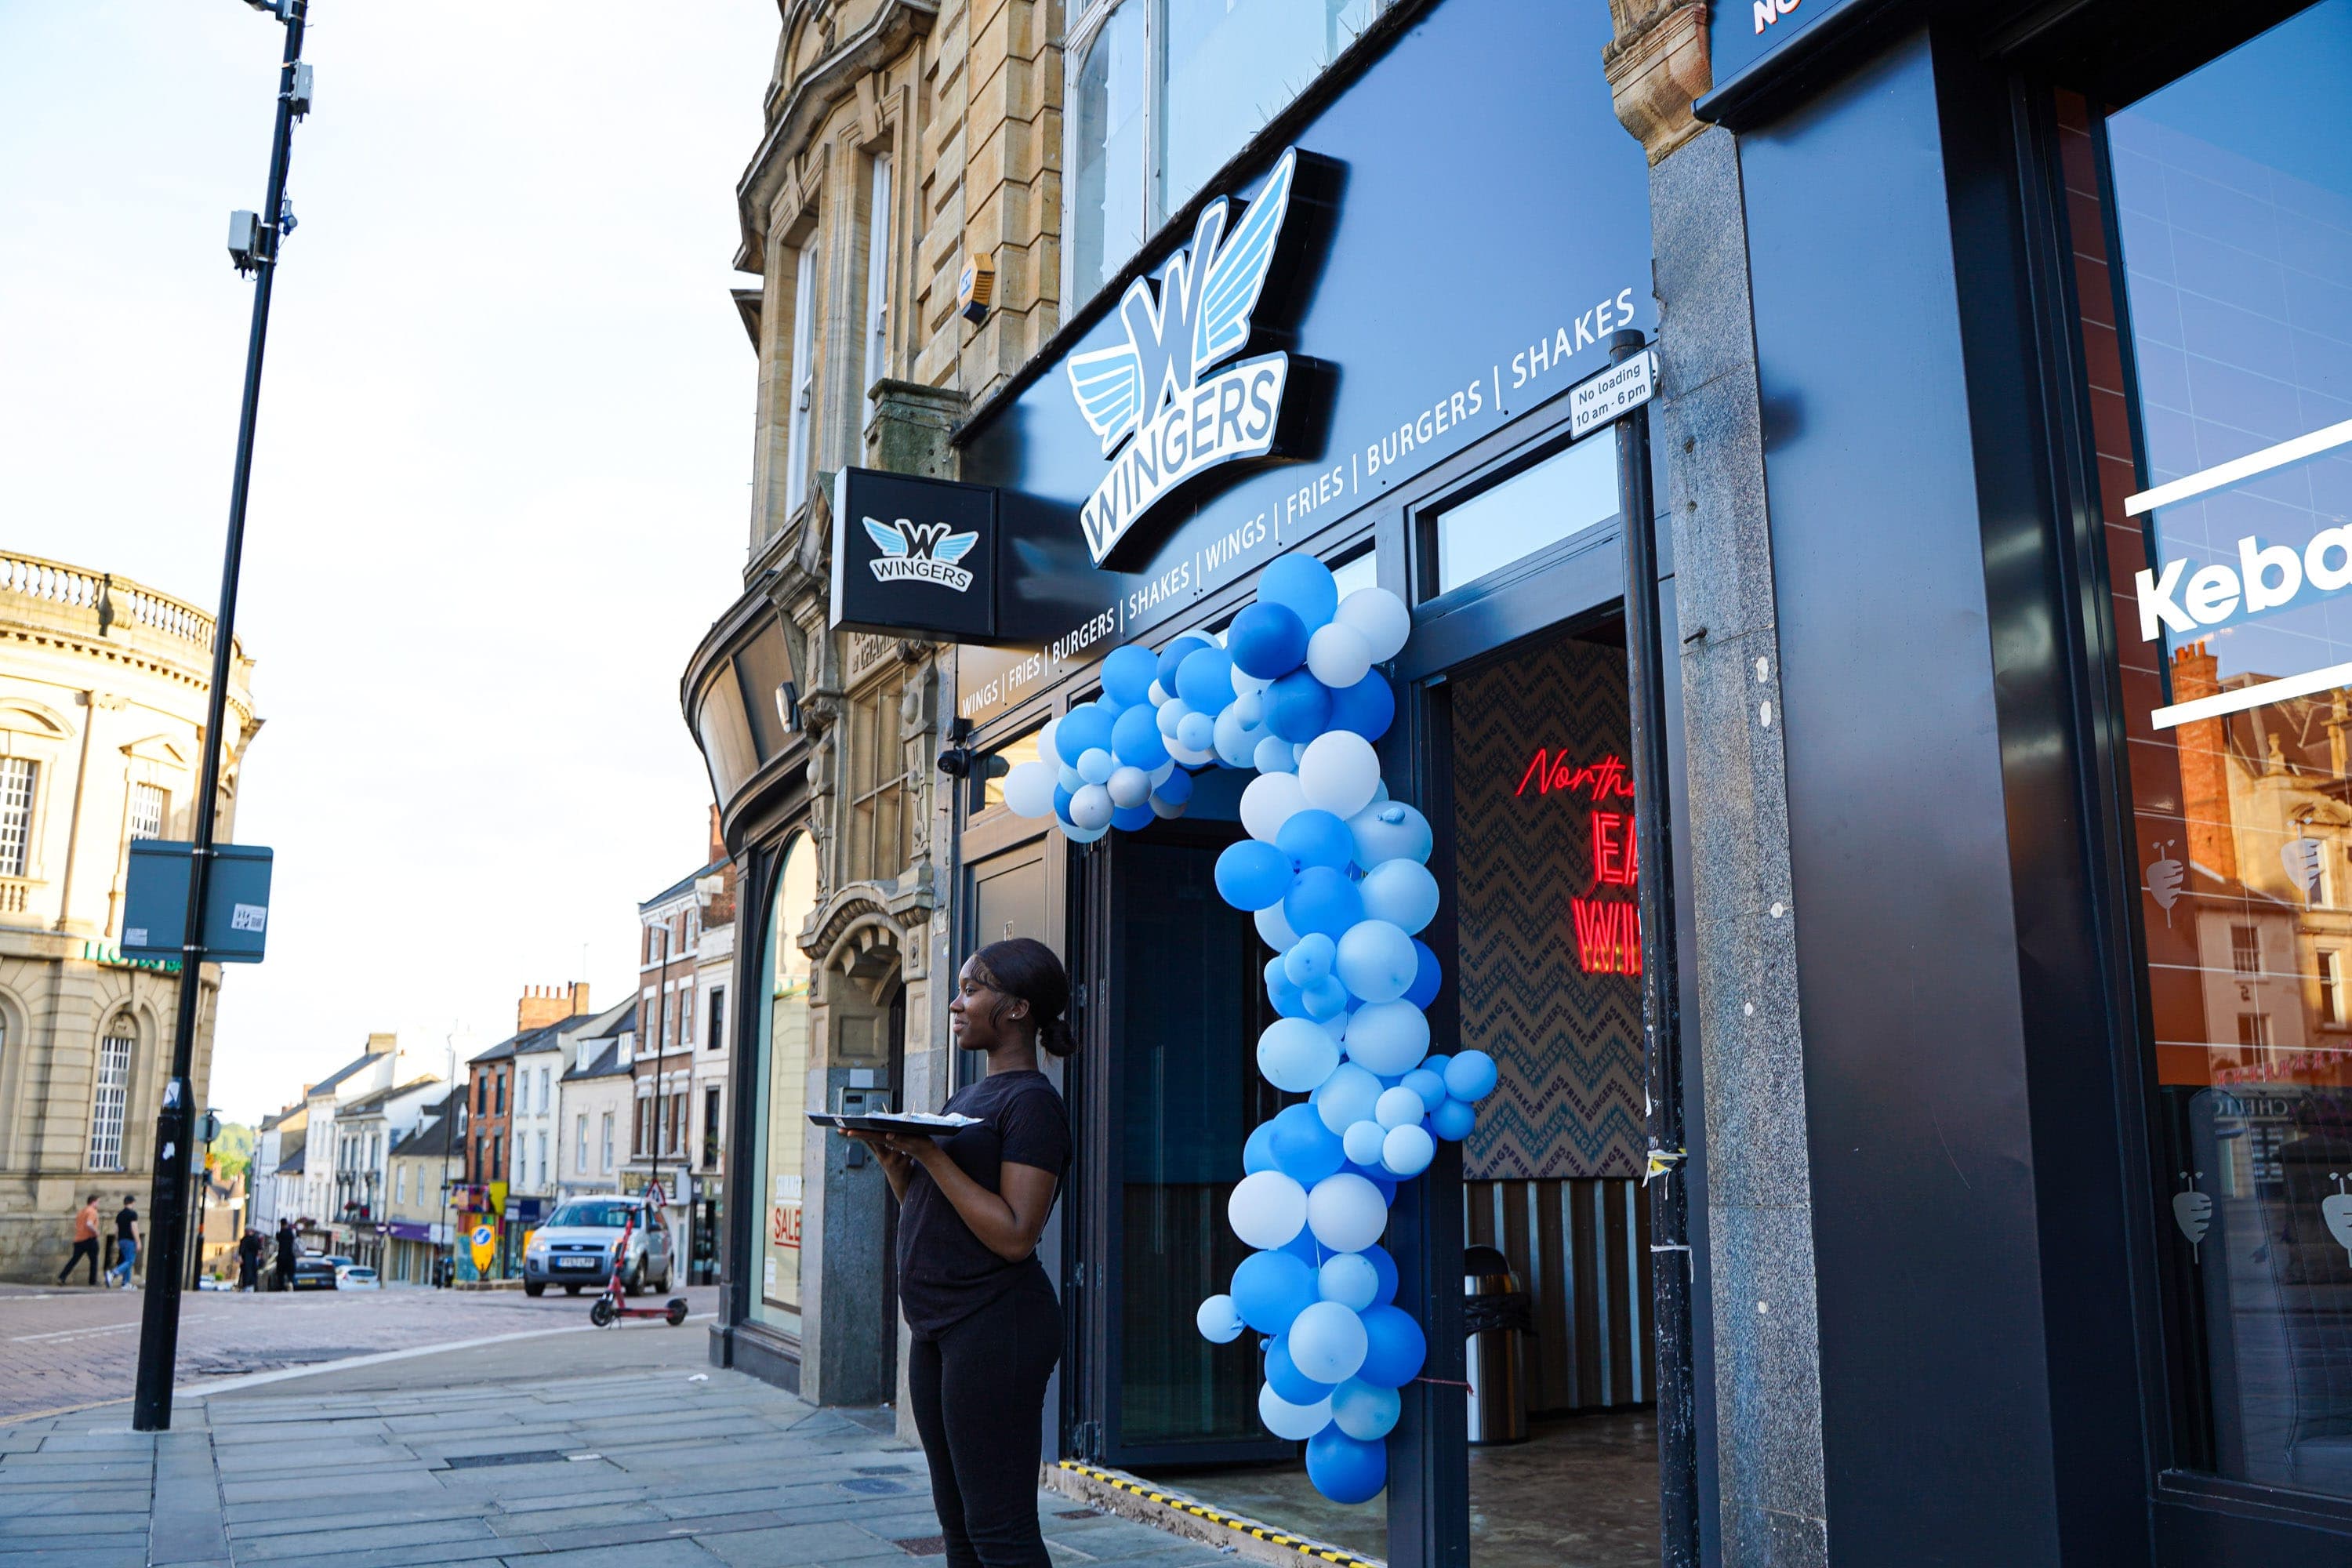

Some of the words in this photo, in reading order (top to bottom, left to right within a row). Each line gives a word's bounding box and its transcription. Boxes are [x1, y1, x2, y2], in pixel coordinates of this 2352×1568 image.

[1577, 411, 1589, 427] 10
[1592, 403, 1609, 419] am
[1617, 391, 1625, 405] 6
[1628, 383, 1646, 403] pm
[1578, 390, 1595, 405] No
[1599, 365, 1640, 394] loading
[1085, 369, 1276, 553] WINGERS
[962, 679, 999, 718] WINGS
[1008, 652, 1040, 691] FRIES
[1052, 608, 1115, 666] BURGERS
[1129, 561, 1190, 619] SHAKES
[1205, 513, 1267, 573] WINGS
[1286, 465, 1345, 525] FRIES
[1367, 379, 1483, 477] BURGERS
[1512, 287, 1635, 390] SHAKES
[873, 561, 968, 588] WINGERS
[1530, 1002, 1563, 1046] BURGERS
[1589, 1006, 1617, 1042] WINGS
[1506, 1078, 1536, 1119] SHAKES
[1534, 1075, 1564, 1112] WINGS
[1562, 1081, 1587, 1113] FRIES
[1584, 1077, 1617, 1122] BURGERS
[1616, 1083, 1645, 1122] SHAKES
[775, 1207, 801, 1243] SALE
